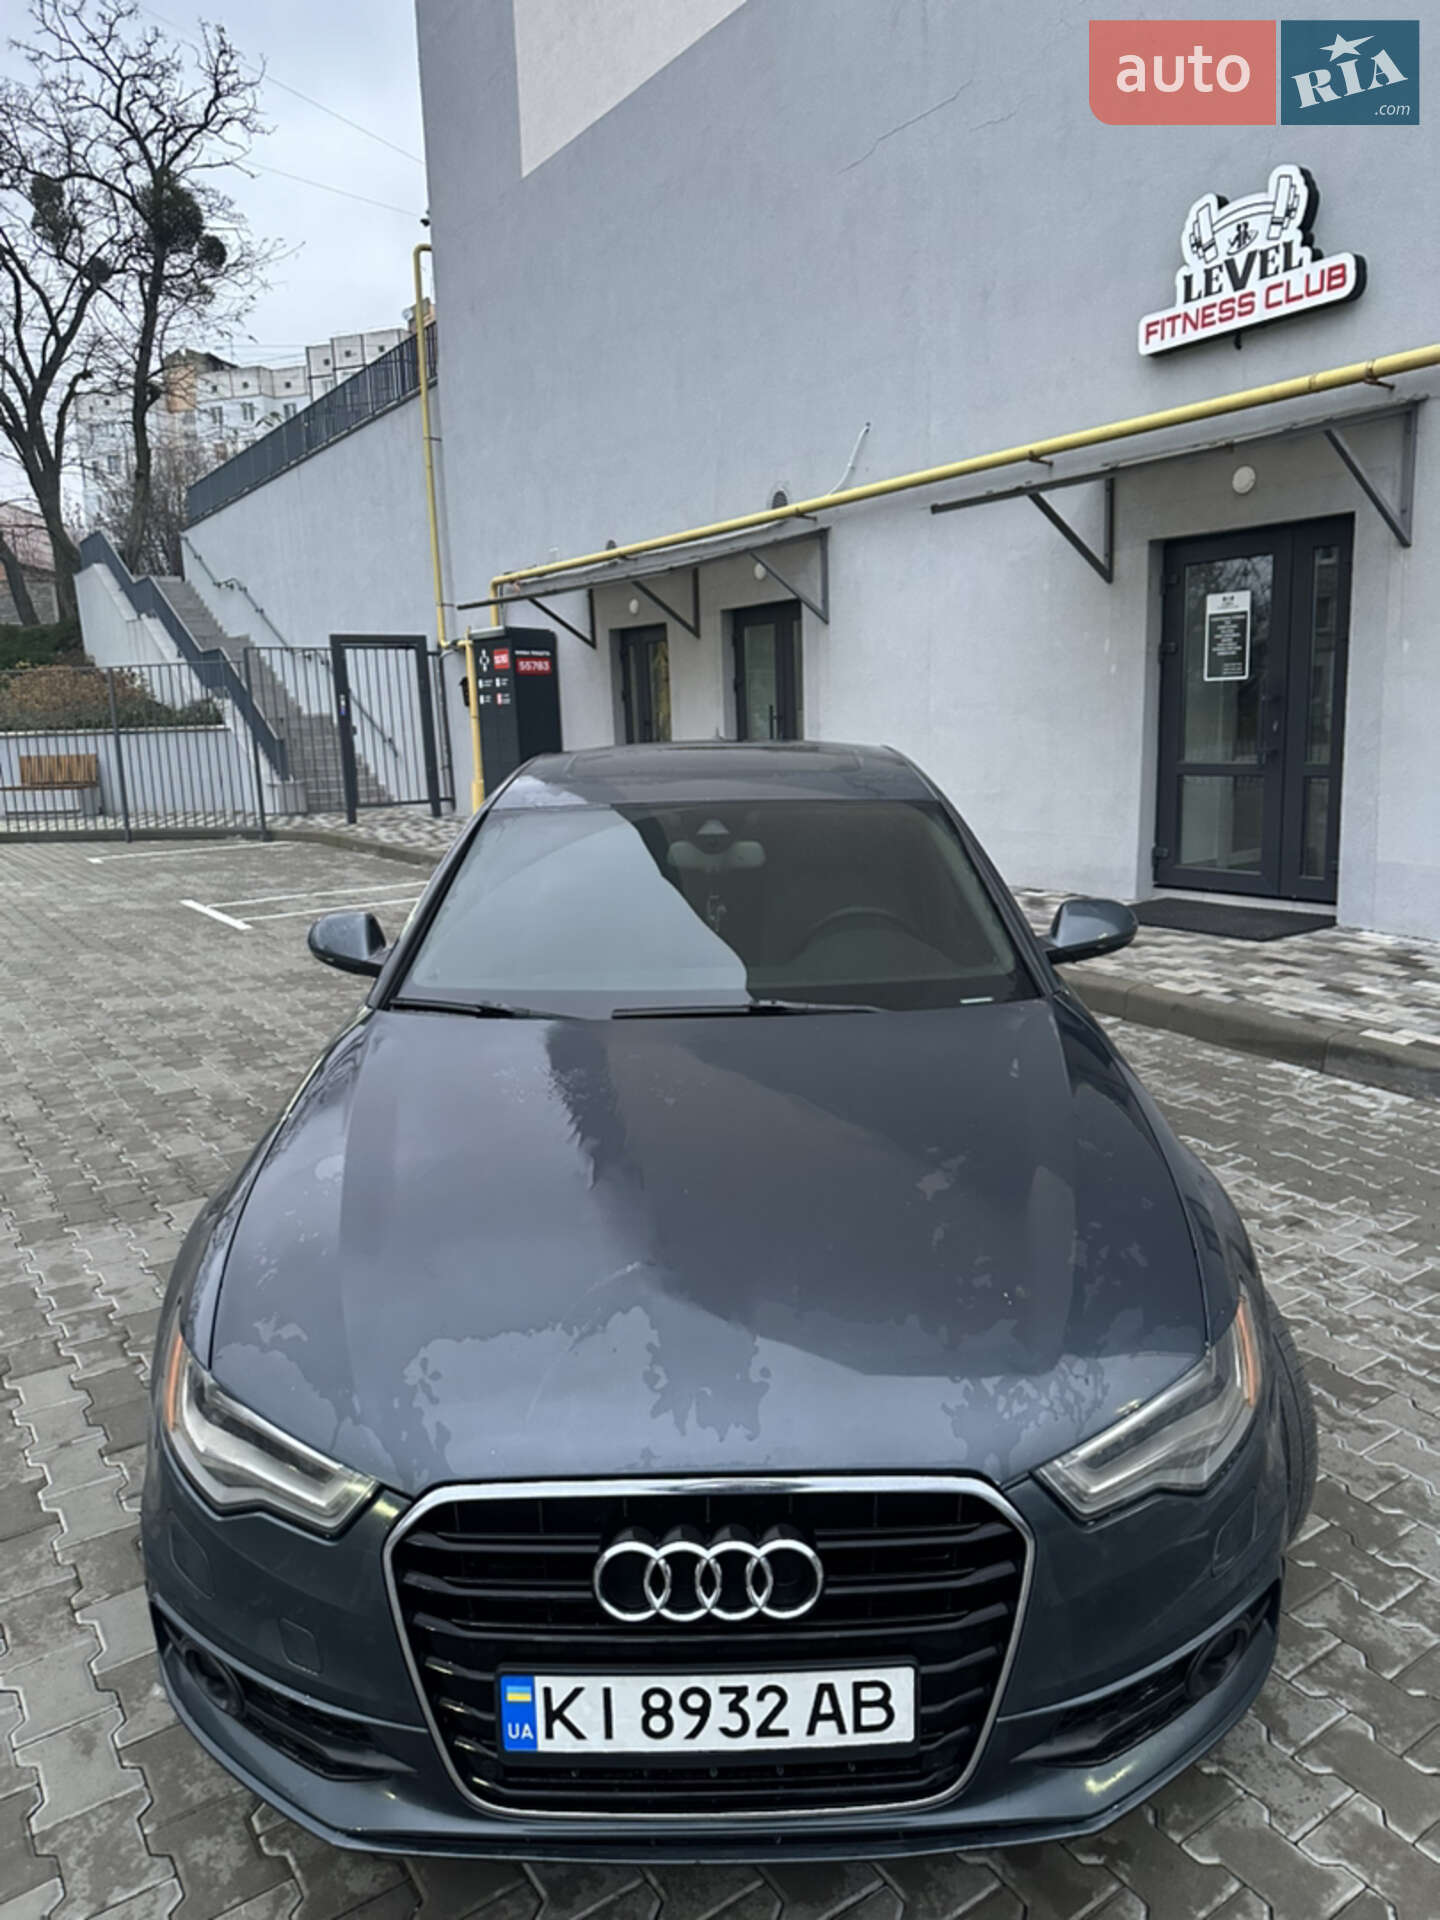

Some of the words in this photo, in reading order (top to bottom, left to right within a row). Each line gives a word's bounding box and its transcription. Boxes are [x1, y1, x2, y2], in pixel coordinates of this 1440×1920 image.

[1183, 240, 1304, 304] LEVEL
[1145, 291, 1256, 345] FITNESS
[1264, 262, 1347, 308] CLUB
[508, 1723, 534, 1740] UA
[542, 1686, 614, 1741] KI
[641, 1685, 790, 1741] 8932
[806, 1680, 896, 1736] AB
